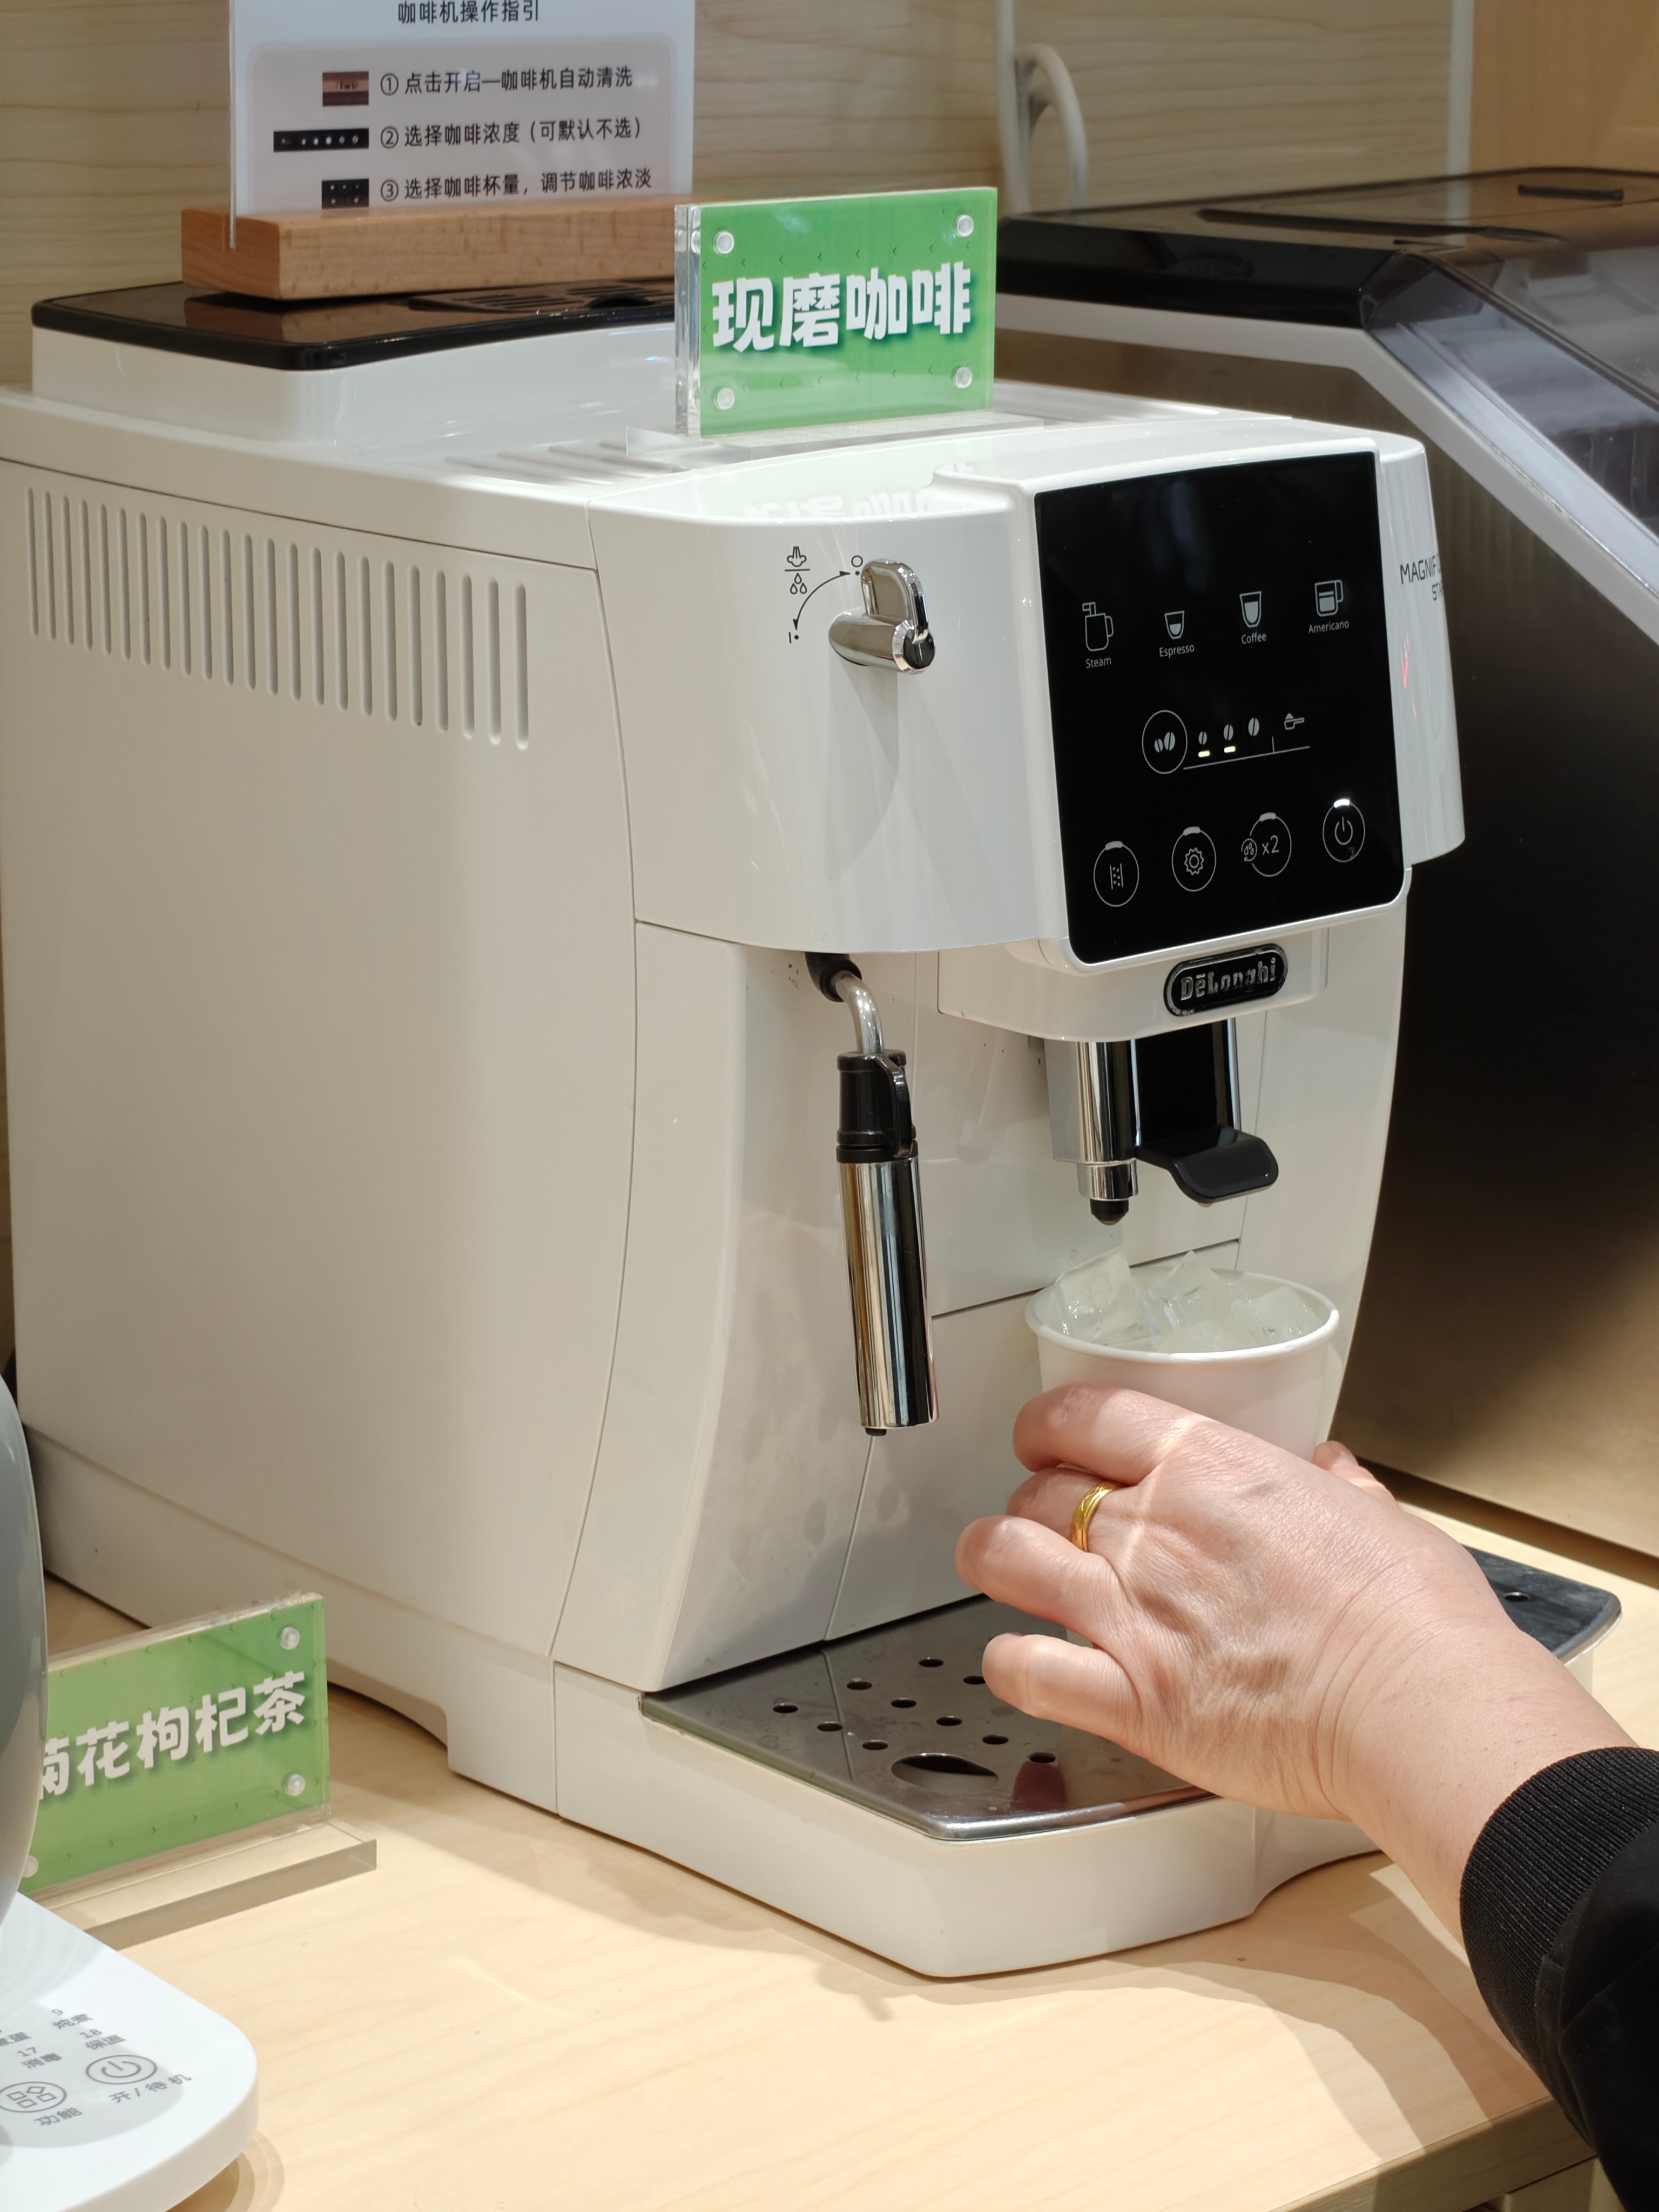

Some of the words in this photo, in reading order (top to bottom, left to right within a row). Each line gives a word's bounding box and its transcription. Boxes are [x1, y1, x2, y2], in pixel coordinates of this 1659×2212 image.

[398, 0, 538, 24] 咖啡机操作指引
[712, 261, 971, 353] 现磨咖啡
[1308, 621, 1350, 634] Americano
[1241, 632, 1267, 644] Coffee
[1159, 644, 1195, 658] Espresso
[1085, 657, 1111, 669] Steam
[1262, 835, 1279, 855] x2
[79, 2028, 103, 2039] 18
[85, 2034, 126, 2051] 保温
[17, 2047, 37, 2057] 17
[34, 2107, 83, 2126] 功能
